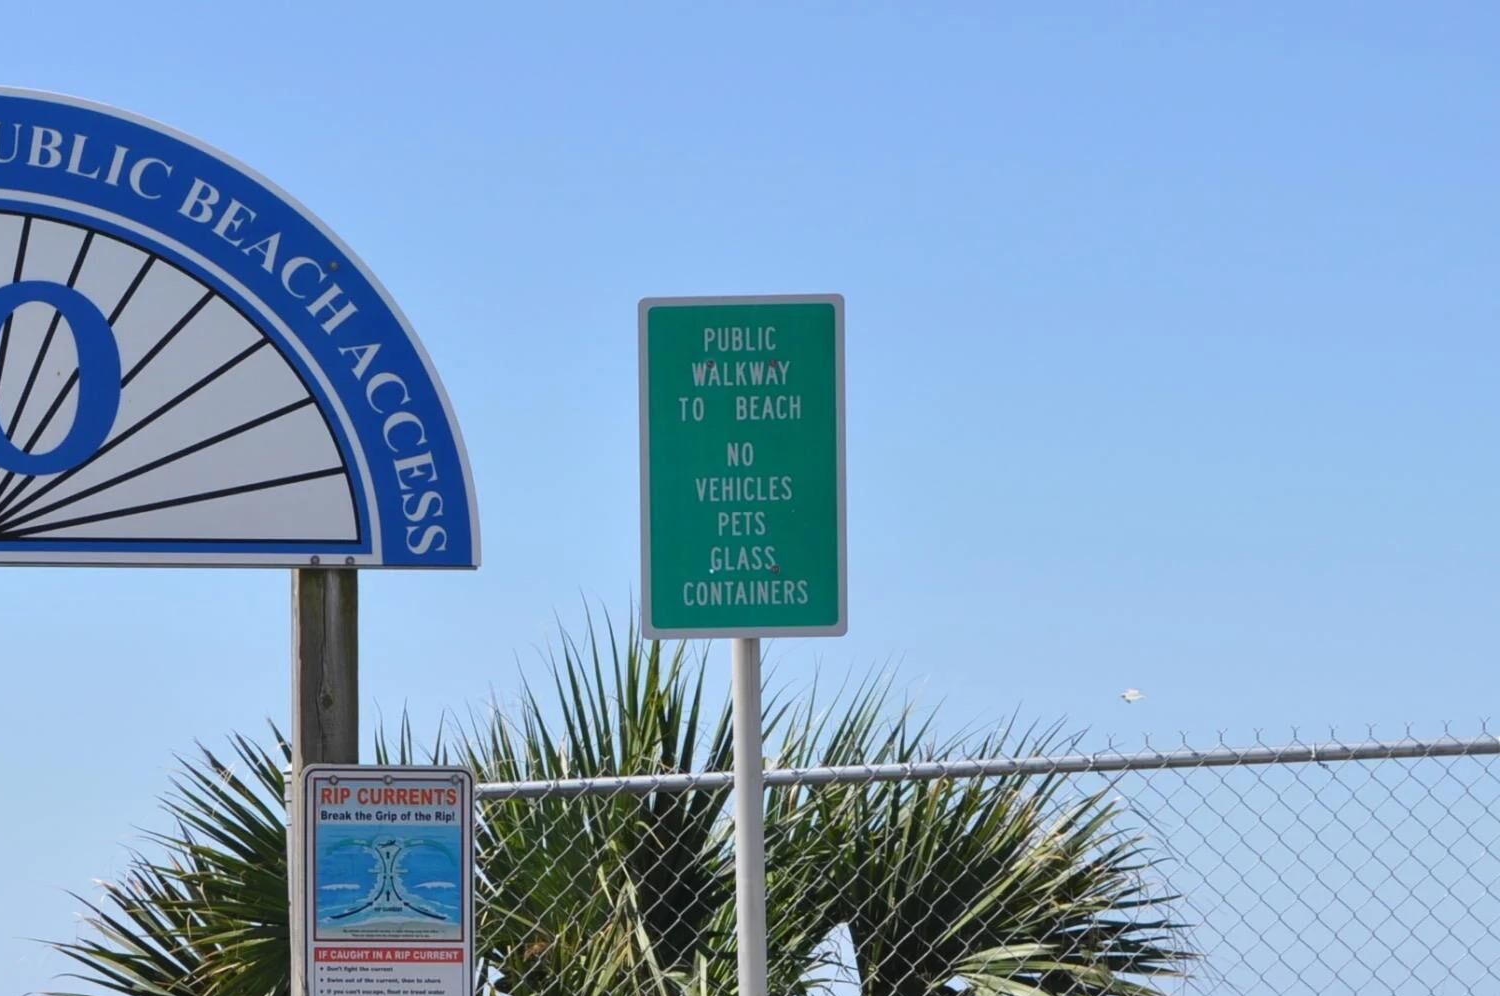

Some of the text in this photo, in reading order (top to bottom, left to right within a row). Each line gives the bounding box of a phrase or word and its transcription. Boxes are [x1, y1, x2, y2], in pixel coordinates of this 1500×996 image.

[703, 327, 777, 352] PUBLIC
[177, 175, 364, 335] BEACH
[339, 342, 447, 557] ACCESS
[691, 361, 790, 387] WALKWAY
[679, 396, 801, 422] TO BEACH
[727, 442, 754, 467] NO
[695, 476, 793, 503] VEHICLES
[718, 512, 766, 537] PETS
[710, 546, 777, 572] GLASS
[683, 580, 809, 606] CONTAINERS
[321, 788, 457, 805] RIP CURRENTS
[321, 811, 455, 823] Break the Grip of the Rip!
[318, 951, 458, 960] IF CAUGHT IN A RIP CURRENT
